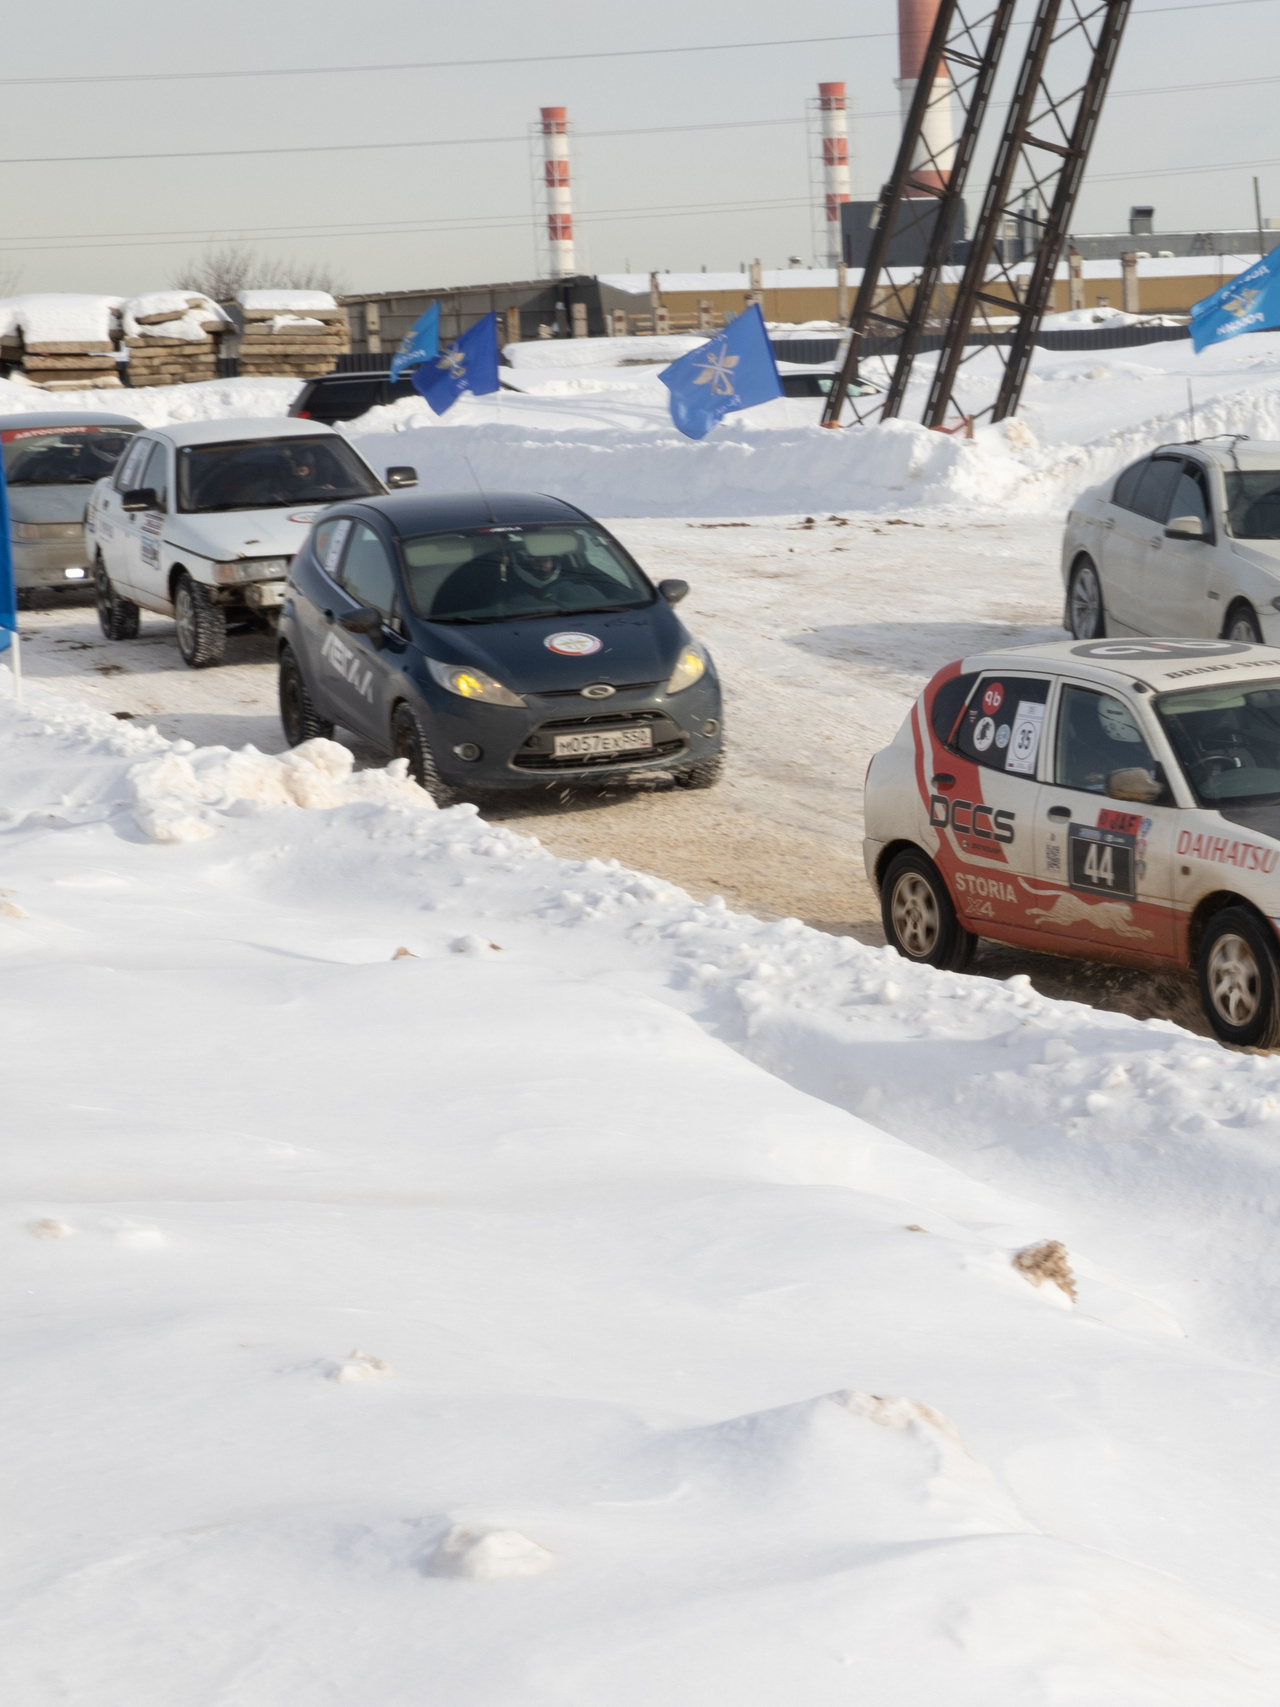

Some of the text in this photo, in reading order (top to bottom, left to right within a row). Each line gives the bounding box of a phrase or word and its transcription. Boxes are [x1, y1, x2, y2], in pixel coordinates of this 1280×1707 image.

[1162, 664, 1237, 680] BRAKE
[930, 794, 1015, 844] DCCS
[1083, 843, 1115, 887] 44
[1177, 829, 1280, 874] DAIHATSU
[954, 872, 1018, 904] STORIA
